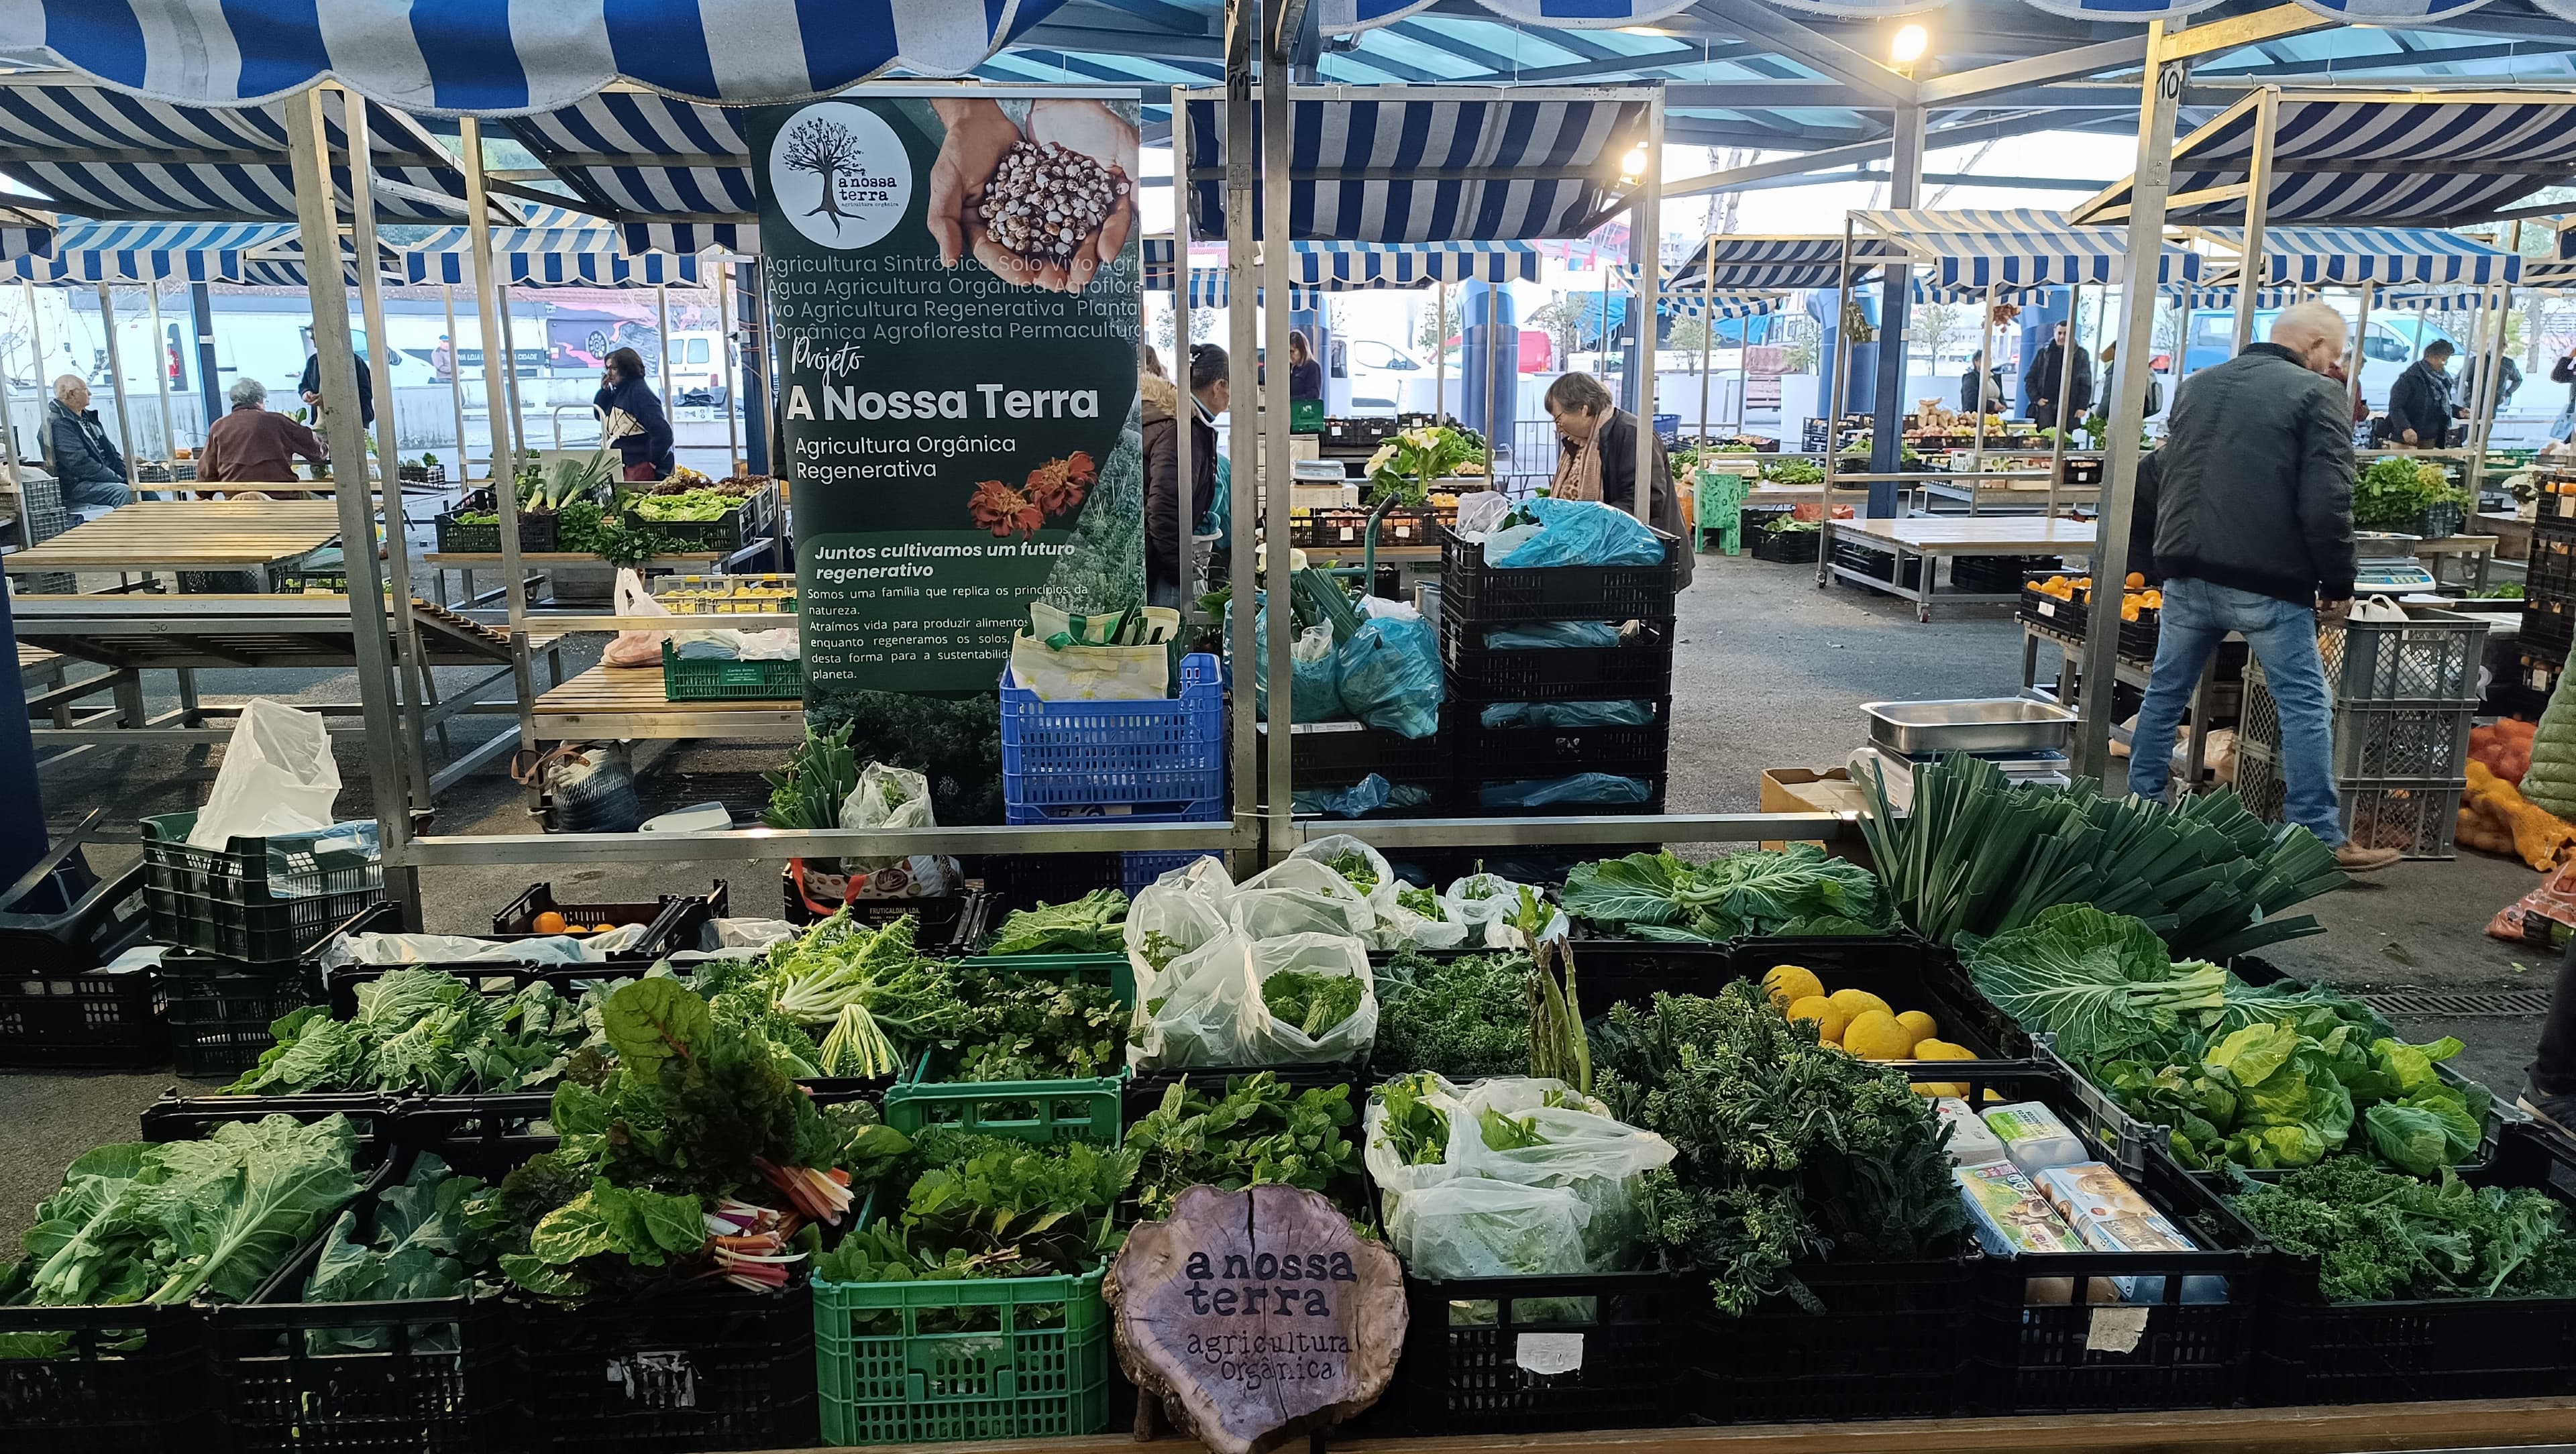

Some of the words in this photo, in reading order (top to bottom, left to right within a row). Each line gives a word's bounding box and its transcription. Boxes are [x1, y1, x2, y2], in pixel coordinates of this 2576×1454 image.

[2157, 70, 2180, 99] 10
[839, 178, 848, 188] a
[851, 178, 897, 188] nossa
[839, 188, 888, 201] terra
[765, 254, 877, 278] Agricultura
[884, 253, 995, 276] Sintrópica
[999, 253, 1042, 270] Solo
[1049, 254, 1093, 271] Vivo
[769, 274, 816, 300] Água
[824, 276, 941, 298] Agricultura
[947, 275, 1046, 296] Orgânica
[801, 299, 918, 323] Agricultura
[924, 299, 1065, 322] Regenerativa
[774, 322, 866, 340] Orgânica
[873, 321, 1003, 343] Agrofloresta
[791, 335, 865, 387] Projeto
[786, 385, 815, 421] A
[824, 386, 967, 421] Nossa
[976, 383, 1099, 418] Terra
[795, 436, 910, 460] Agricultura
[916, 434, 1016, 458] Orgânica
[797, 459, 937, 485] Regenerativa
[815, 543, 876, 560] Juntos
[880, 541, 982, 559] cultivamos
[986, 545, 1016, 557] um
[1020, 540, 1076, 556] futuro
[816, 562, 934, 584] regenerativo
[807, 588, 844, 600] Somos
[850, 590, 876, 599] uma
[881, 586, 920, 598] família
[926, 588, 947, 601] que
[953, 585, 990, 600] replica
[995, 588, 1009, 596] os
[1014, 583, 1069, 598] princípios
[1074, 584, 1088, 596] da
[808, 604, 861, 616] natureza.
[810, 620, 859, 632] Atraímos
[863, 618, 888, 630] vida
[893, 620, 919, 632] para
[923, 617, 971, 631] produzir
[810, 636, 864, 650] enquanto
[873, 635, 949, 649] regeneramos
[957, 635, 970, 644] os
[978, 634, 1010, 644] solos,
[811, 653, 842, 664] desta
[849, 651, 883, 663] forma
[891, 653, 918, 664] para
[924, 652, 930, 660] a
[812, 669, 857, 681] planeta.
[1185, 1251, 1214, 1280] a
[1222, 1251, 1358, 1282] nossa
[1184, 1281, 1330, 1317] terra
[1187, 1330, 1352, 1364] agricultura
[1221, 1357, 1334, 1390] orgânica
